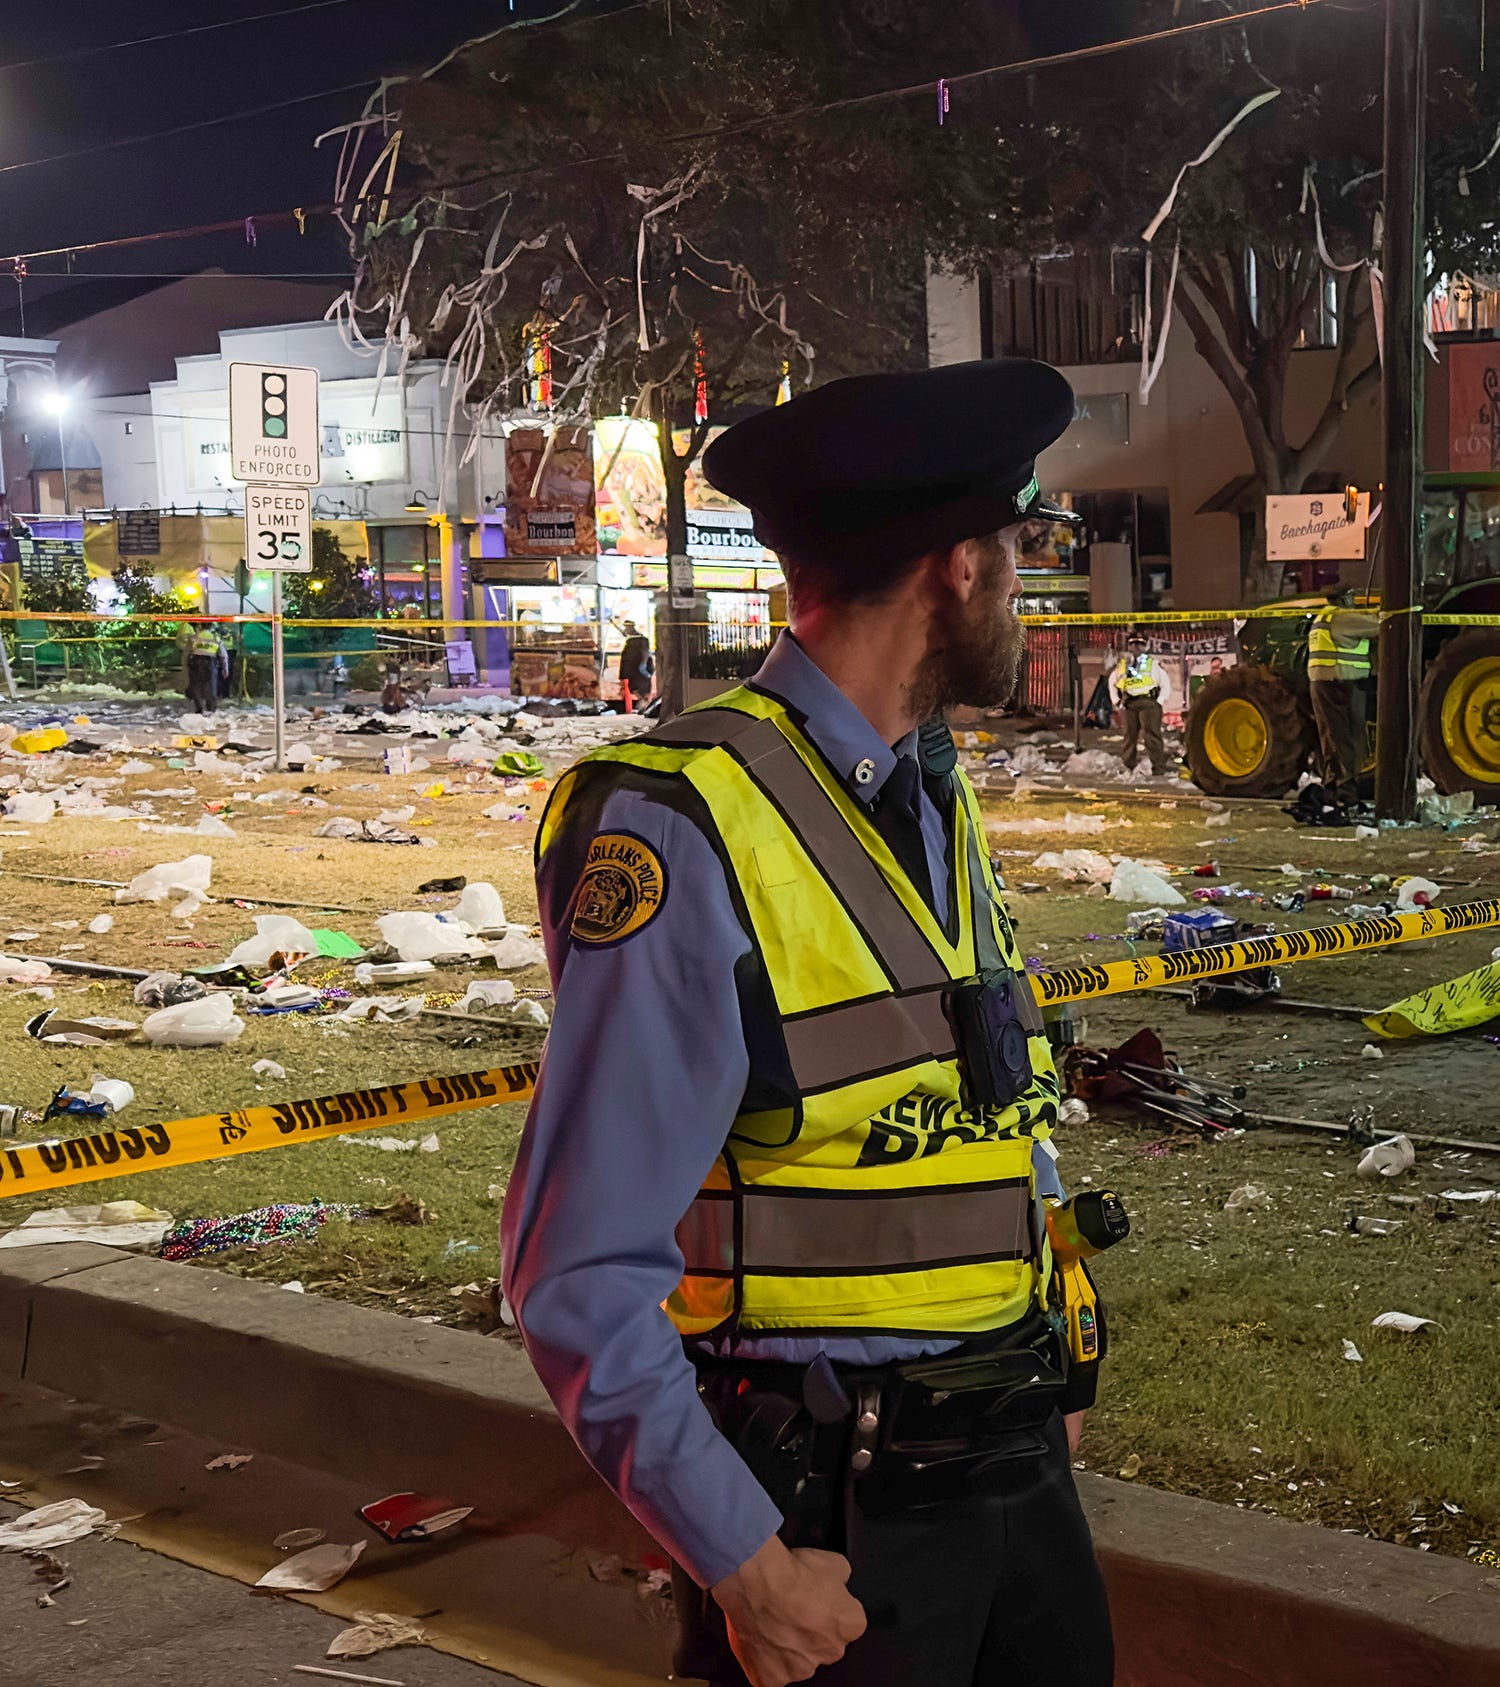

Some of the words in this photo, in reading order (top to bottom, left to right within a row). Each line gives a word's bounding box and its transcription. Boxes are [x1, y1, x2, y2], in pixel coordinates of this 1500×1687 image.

[254, 444, 297, 459] PHOTO
[239, 460, 312, 477] ENFORCED
[251, 496, 305, 510] SPEED
[257, 513, 299, 527] LIMIT
[256, 530, 302, 560] 35
[855, 758, 876, 785] 6
[633, 861, 660, 906] POLICE
